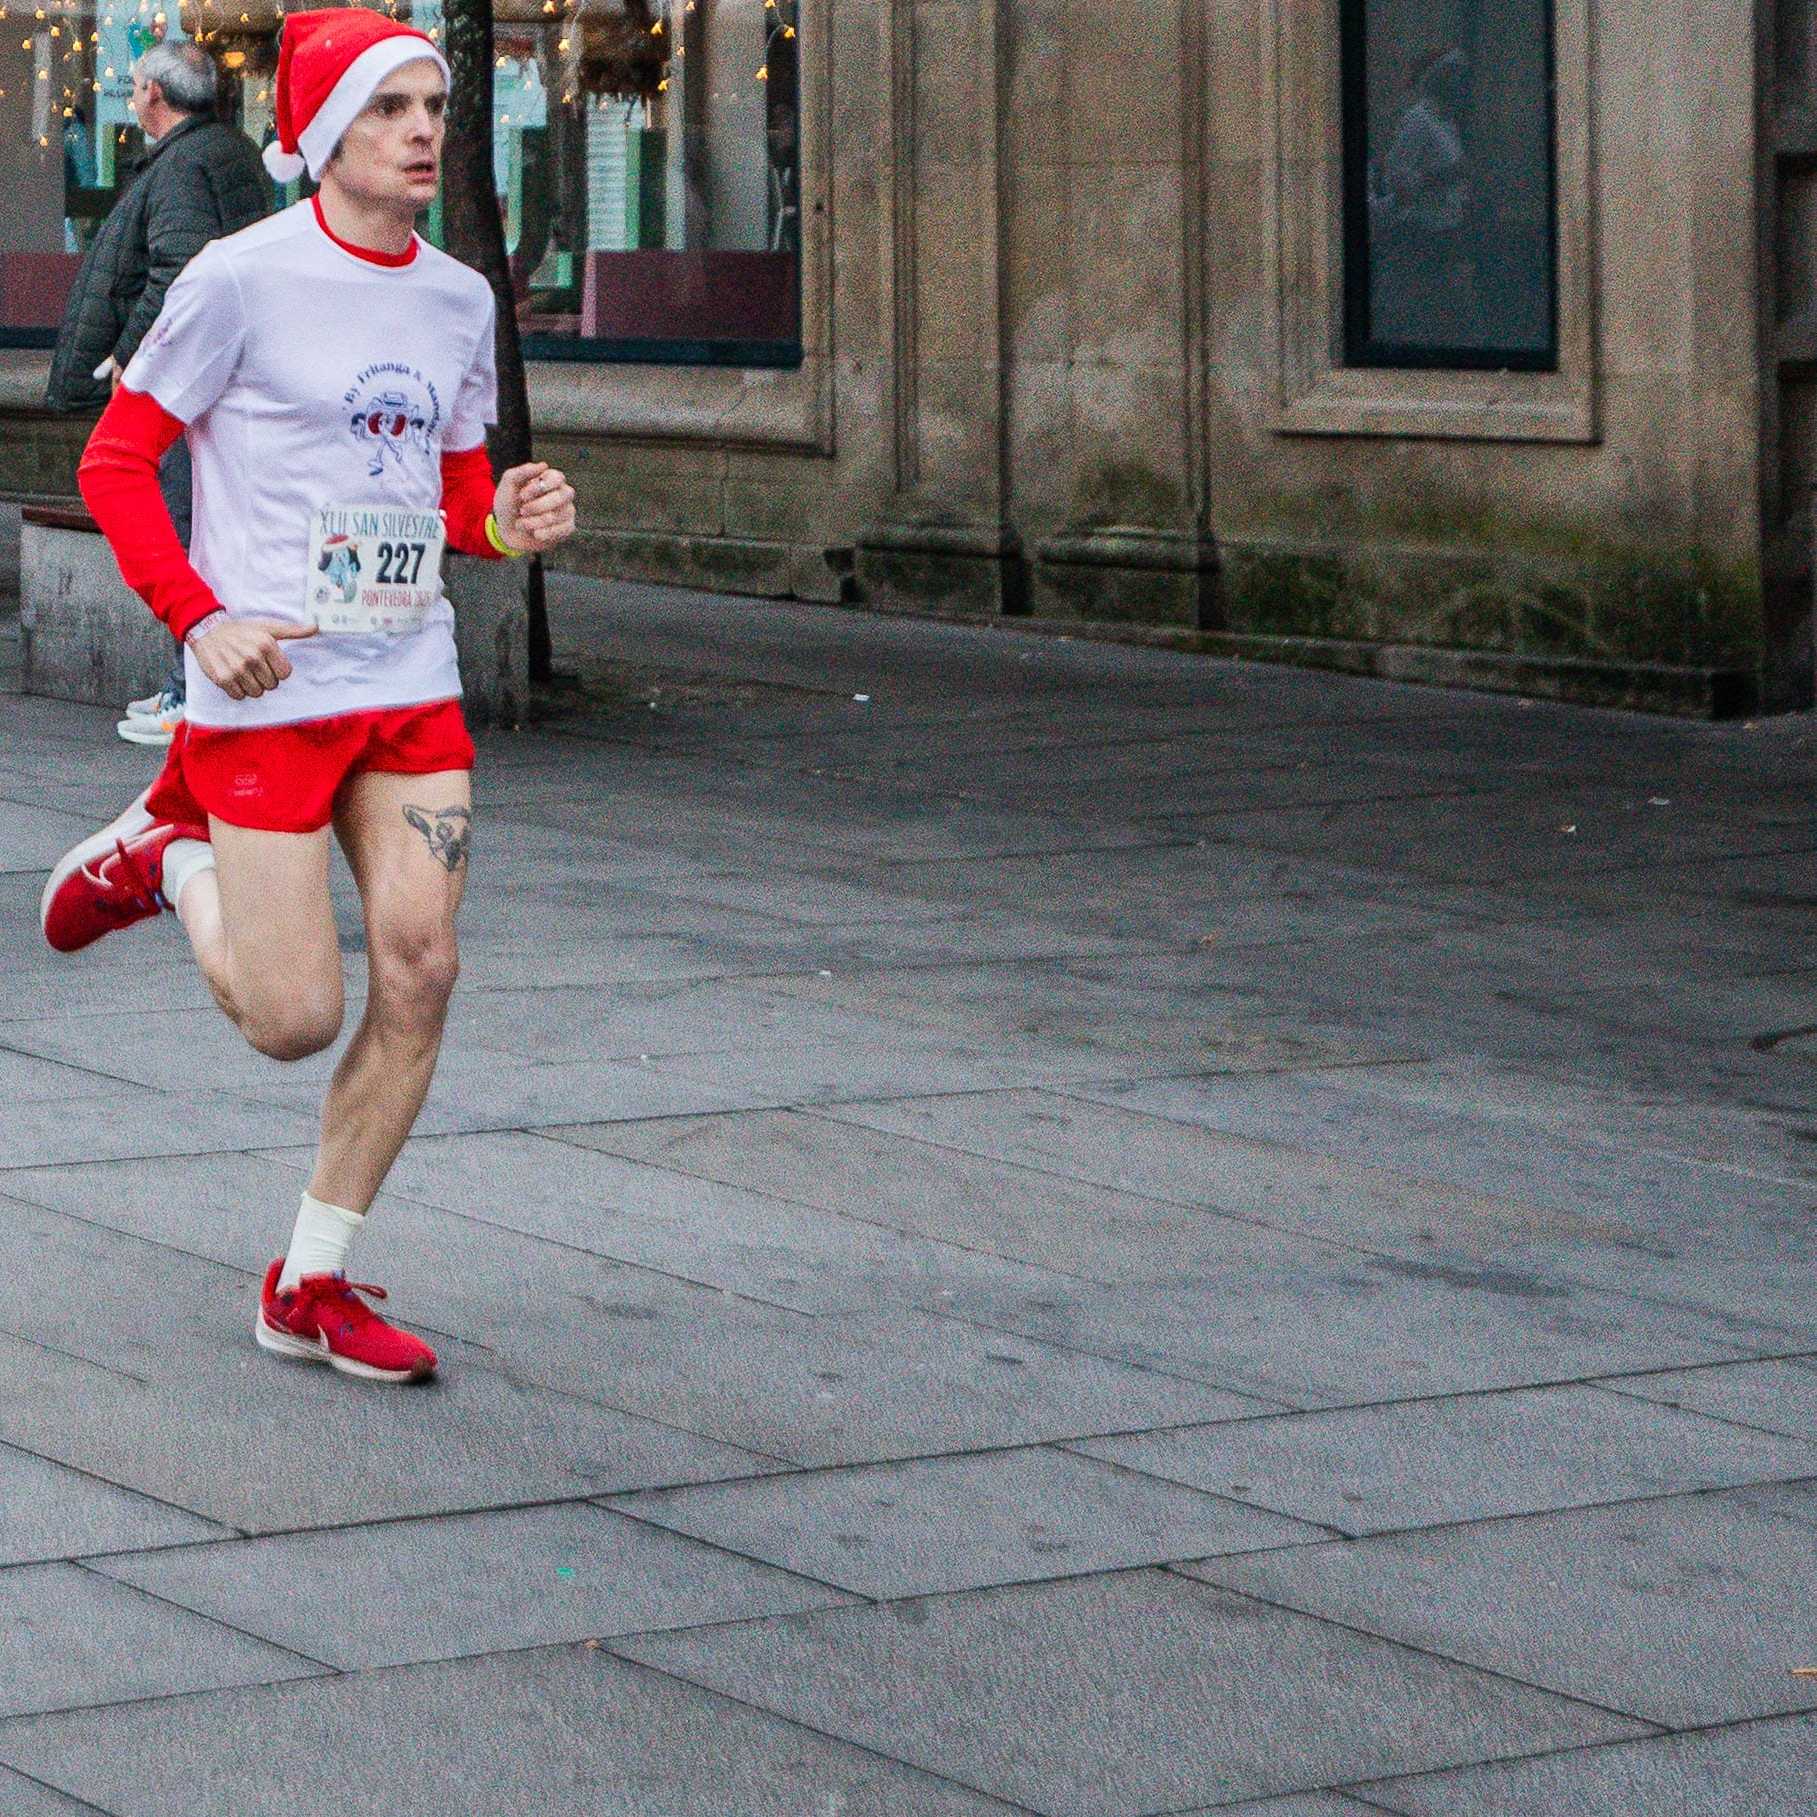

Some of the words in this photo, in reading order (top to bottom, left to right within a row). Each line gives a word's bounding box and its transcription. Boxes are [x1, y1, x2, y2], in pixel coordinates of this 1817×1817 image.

[352, 510, 379, 537] SAN
[382, 512, 440, 540] SILVESTRE
[375, 541, 427, 585] 227
[361, 589, 413, 608] PONTEVEDRA
